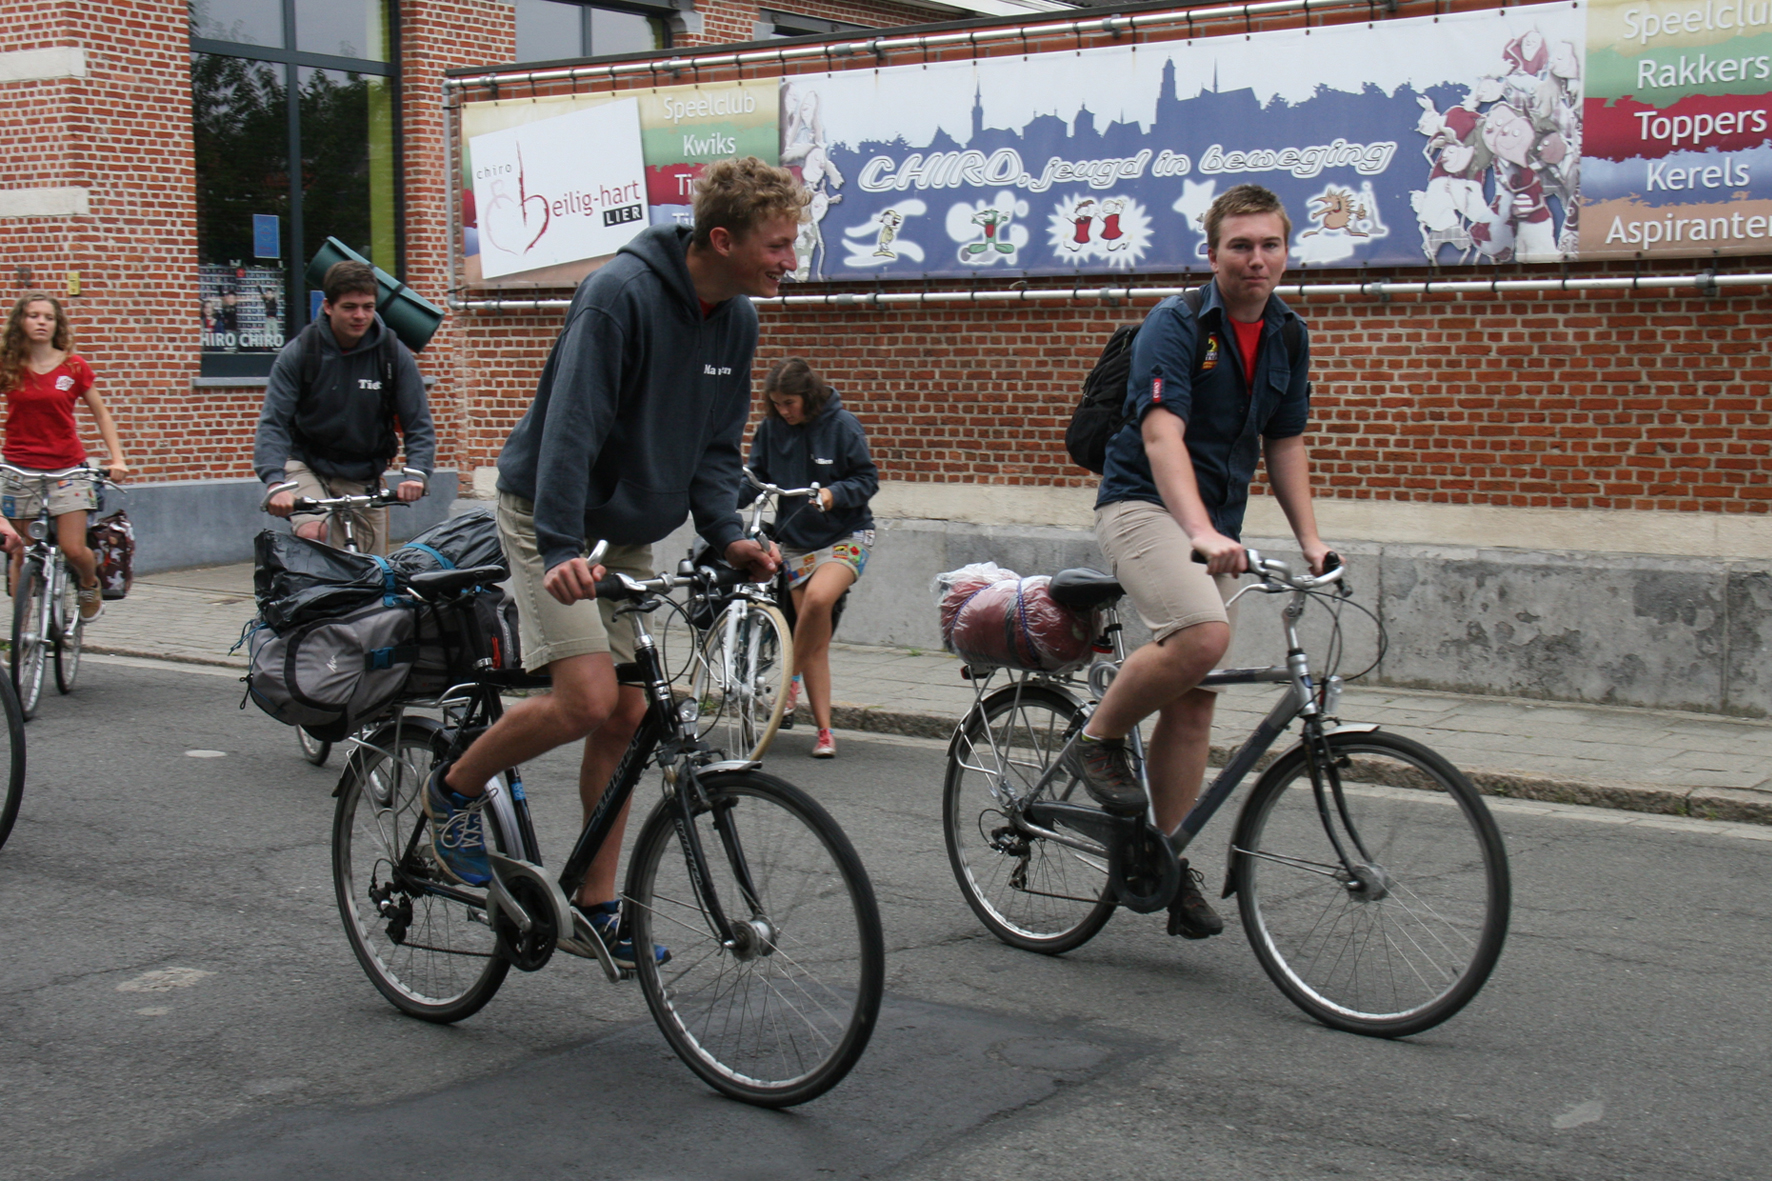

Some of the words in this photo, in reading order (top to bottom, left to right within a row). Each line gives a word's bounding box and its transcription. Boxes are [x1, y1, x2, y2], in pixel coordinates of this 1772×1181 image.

[1623, 0, 1772, 45] Speelclu
[1637, 53, 1770, 89] Rakkers
[664, 91, 756, 123] Speelclub
[683, 133, 736, 156] Kwiks
[1634, 109, 1768, 146] Toppers
[476, 163, 512, 180] chiro
[1028, 149, 1153, 193] jeugd
[1151, 149, 1191, 178] in
[1198, 138, 1398, 178] beweging
[1647, 156, 1750, 192] Kerels
[604, 205, 642, 226] LIER
[200, 332, 237, 347] HIRO
[239, 333, 285, 348] CHIRO
